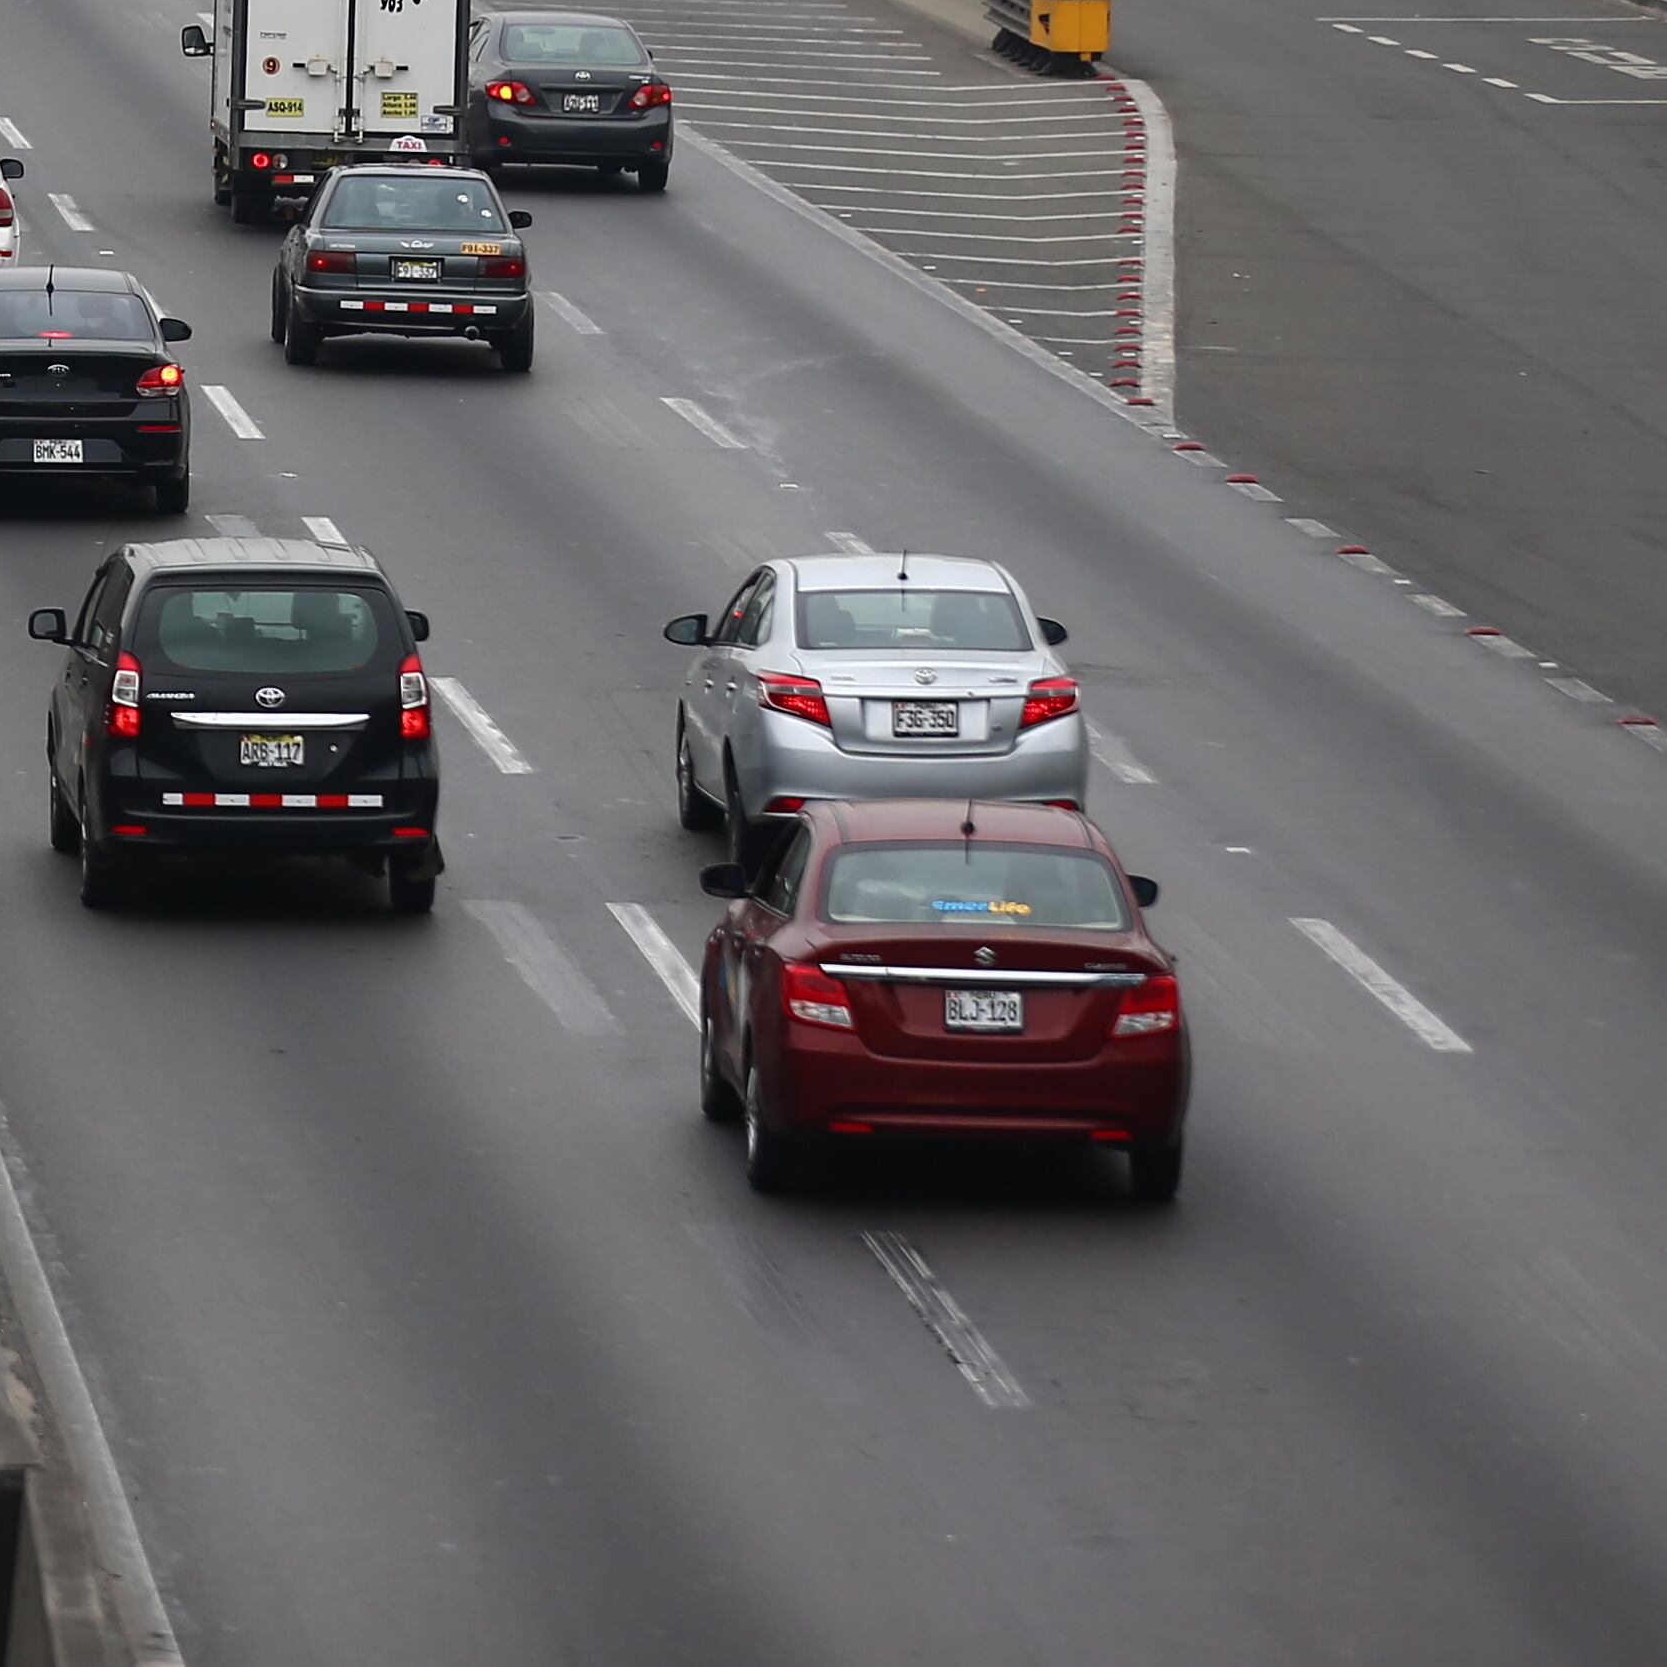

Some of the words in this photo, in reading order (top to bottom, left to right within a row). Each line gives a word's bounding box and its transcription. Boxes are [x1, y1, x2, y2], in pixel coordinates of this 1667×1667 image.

[267, 101, 303, 113] ASQ-914
[397, 141, 421, 149] TAXI
[36, 444, 80, 459] BMK-544
[896, 710, 955, 728] F3G-350
[241, 742, 301, 761] ARB-117
[947, 999, 1018, 1021] BLJ-128
